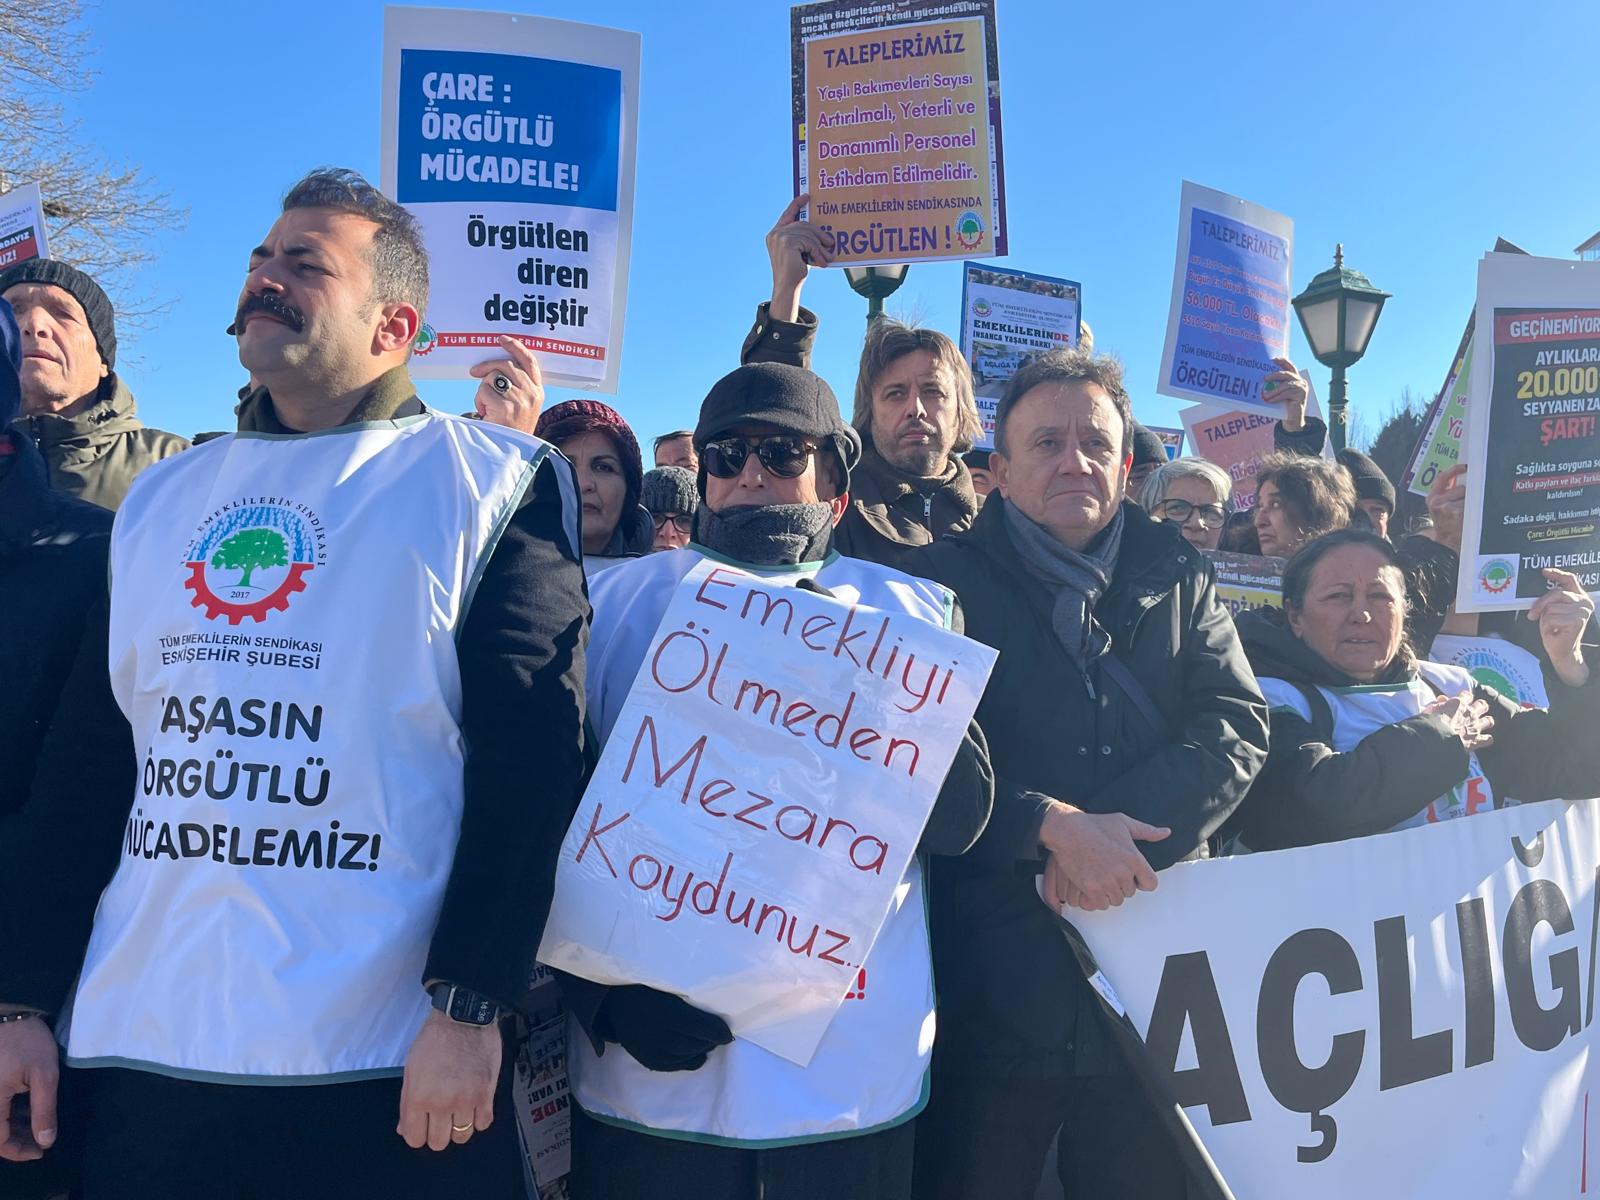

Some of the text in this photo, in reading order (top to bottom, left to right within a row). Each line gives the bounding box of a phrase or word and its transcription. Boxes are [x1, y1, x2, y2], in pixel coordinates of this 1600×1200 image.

[801, 23, 828, 34] ancak
[886, 10, 912, 22] kendi
[824, 29, 965, 69] TALEPLERİMİZ
[422, 72, 511, 105] ÇARE :
[818, 73, 973, 102] Yaşlı Bakımevleri Sayısı
[421, 107, 554, 147] ÖRGÜTLÜ
[816, 98, 976, 129] Artırılmalı, Yeterli ve
[818, 128, 976, 159] Donanımlı Personel
[420, 148, 579, 192] MÜCADELE!
[819, 163, 978, 189] İstihdam Edilmelidir.
[817, 196, 982, 215] TÜM EMEKLİLERİN SENDİKASINDA
[0, 231, 30, 250] RDAYIZ
[467, 214, 588, 252] Örgütlen
[945, 225, 952, 249] !
[1201, 220, 1280, 261] TALEPLERİMİZ
[0, 249, 16, 266] UZ!
[517, 258, 588, 289] diren
[484, 294, 588, 330] değiştir
[1510, 315, 1600, 339] GEÇİNEMİYOR
[973, 319, 1069, 342] EMEKLİLERİNDE
[444, 335, 599, 357] TÜM EMEKERİN SENDİKASI
[1177, 361, 1251, 398] ÖRGÜTLEN
[1517, 367, 1598, 399] 20.000
[1523, 397, 1600, 416] SEYYANEN ZA
[1204, 414, 1281, 442] TALEPLER
[1540, 416, 1595, 447] ŞART!
[1516, 462, 1556, 476] Sağlıkta
[1558, 459, 1592, 473] soyguna
[198, 497, 293, 532] EMEKLİLERİN
[295, 503, 327, 566] SENDİKASI
[1503, 514, 1534, 525] Sadaka
[1522, 554, 1551, 568] TÜM
[1554, 549, 1600, 567] EMEKLİLE
[230, 590, 250, 599] 2017
[1546, 572, 1599, 590] SKASI
[159, 631, 322, 653] TÜM EMEKLİLERİN SENDİKASI
[695, 566, 960, 713] Emekliyi
[162, 645, 321, 670] ESKİŞEHİR ŞUBESİ
[651, 620, 920, 777] Ölmeden
[161, 695, 323, 743] AŞASIN
[620, 714, 889, 875] Mezara
[1143, 830, 1600, 1163] AÇLIĞ
